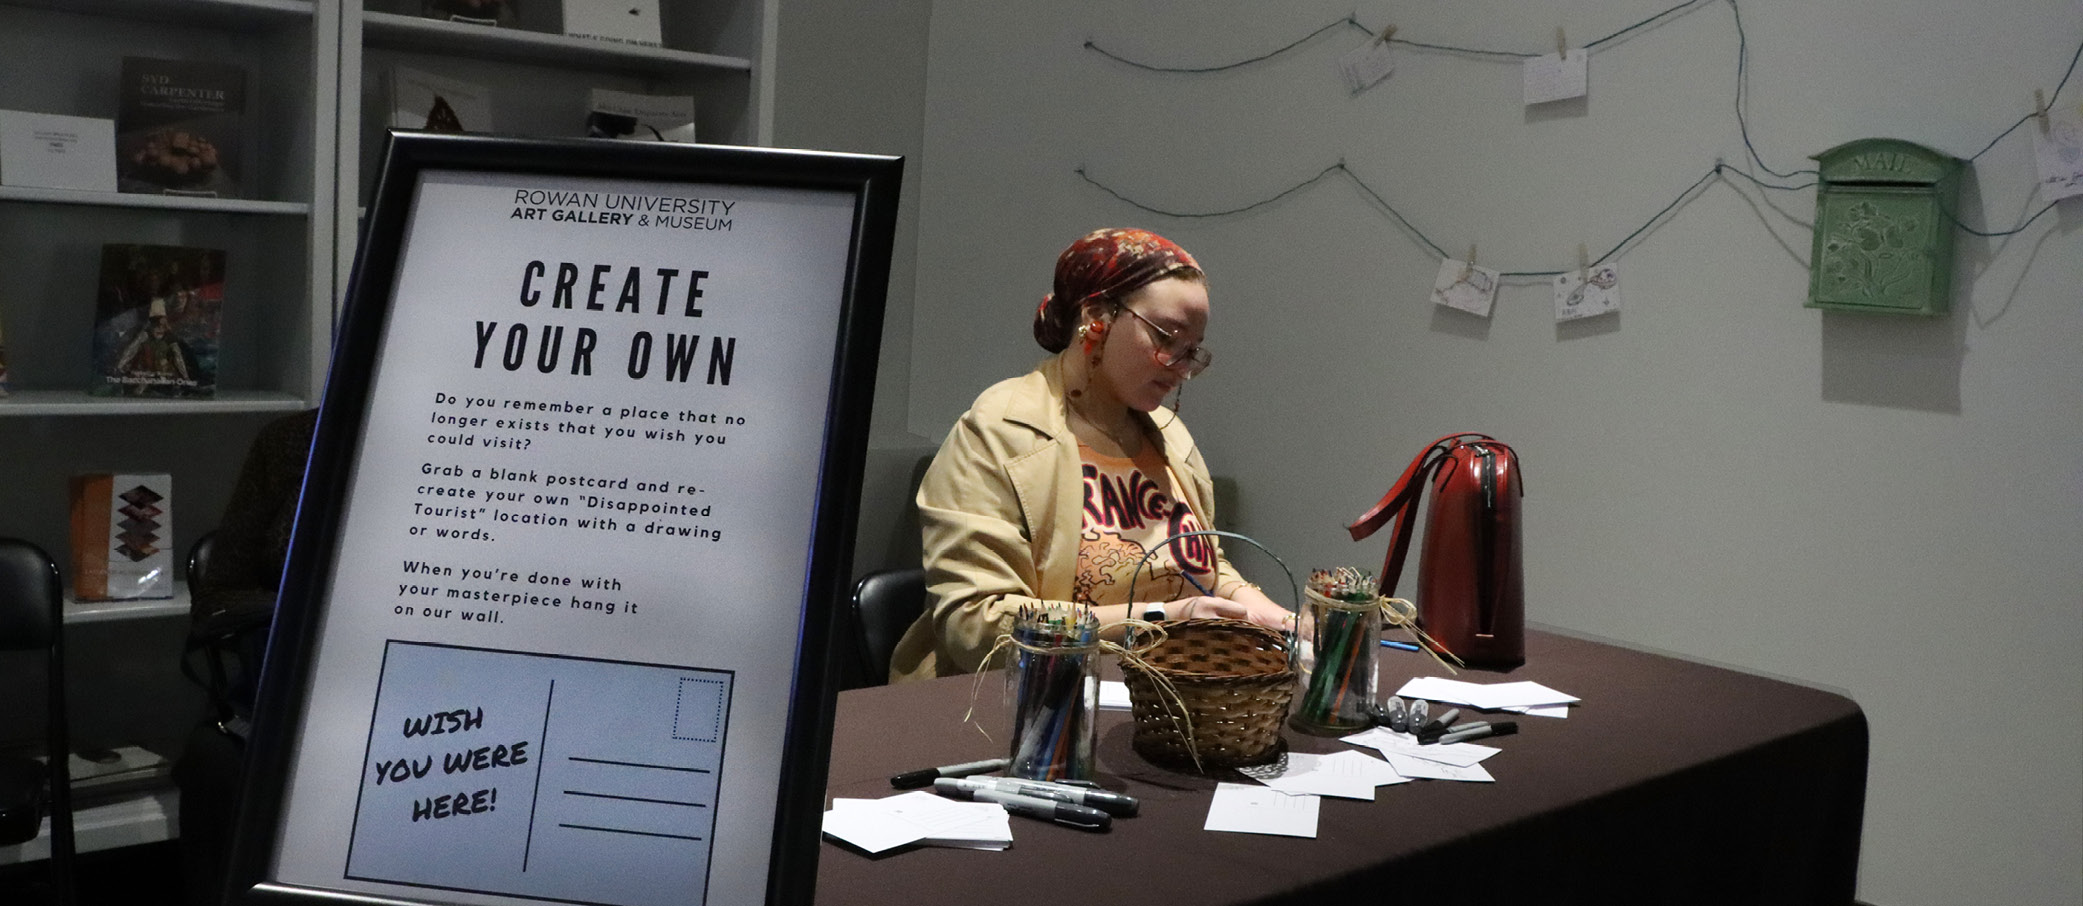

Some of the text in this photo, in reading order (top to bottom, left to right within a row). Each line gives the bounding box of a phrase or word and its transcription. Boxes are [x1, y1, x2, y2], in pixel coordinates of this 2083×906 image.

[140, 86, 225, 100] CARPENTER
[1854, 151, 1912, 174] MAIL
[515, 190, 735, 215] ROWAN UNIVERSITY
[510, 207, 732, 231] ART GALLERY & MUSEUM
[520, 260, 709, 317] CREATE
[474, 321, 736, 386] YOUR OWN
[435, 393, 745, 426] Do you remember a place that no
[428, 434, 531, 450] could visit?
[432, 412, 726, 445] longer exists that you wish you
[422, 463, 704, 495] Grab a blank postcard and re-
[418, 486, 475, 498] create
[486, 491, 525, 502] your
[534, 495, 568, 506] own
[410, 527, 494, 541] or words.
[494, 509, 567, 526] location
[578, 517, 616, 530] with
[626, 523, 635, 532] a
[645, 522, 721, 542] drawing
[404, 561, 621, 591] When you're done with
[394, 606, 503, 623] on our wall.
[399, 585, 638, 614] your masterpiece hang it
[403, 707, 483, 738] WISH
[376, 741, 528, 785] YOU WERE
[412, 788, 497, 822] HERE!
